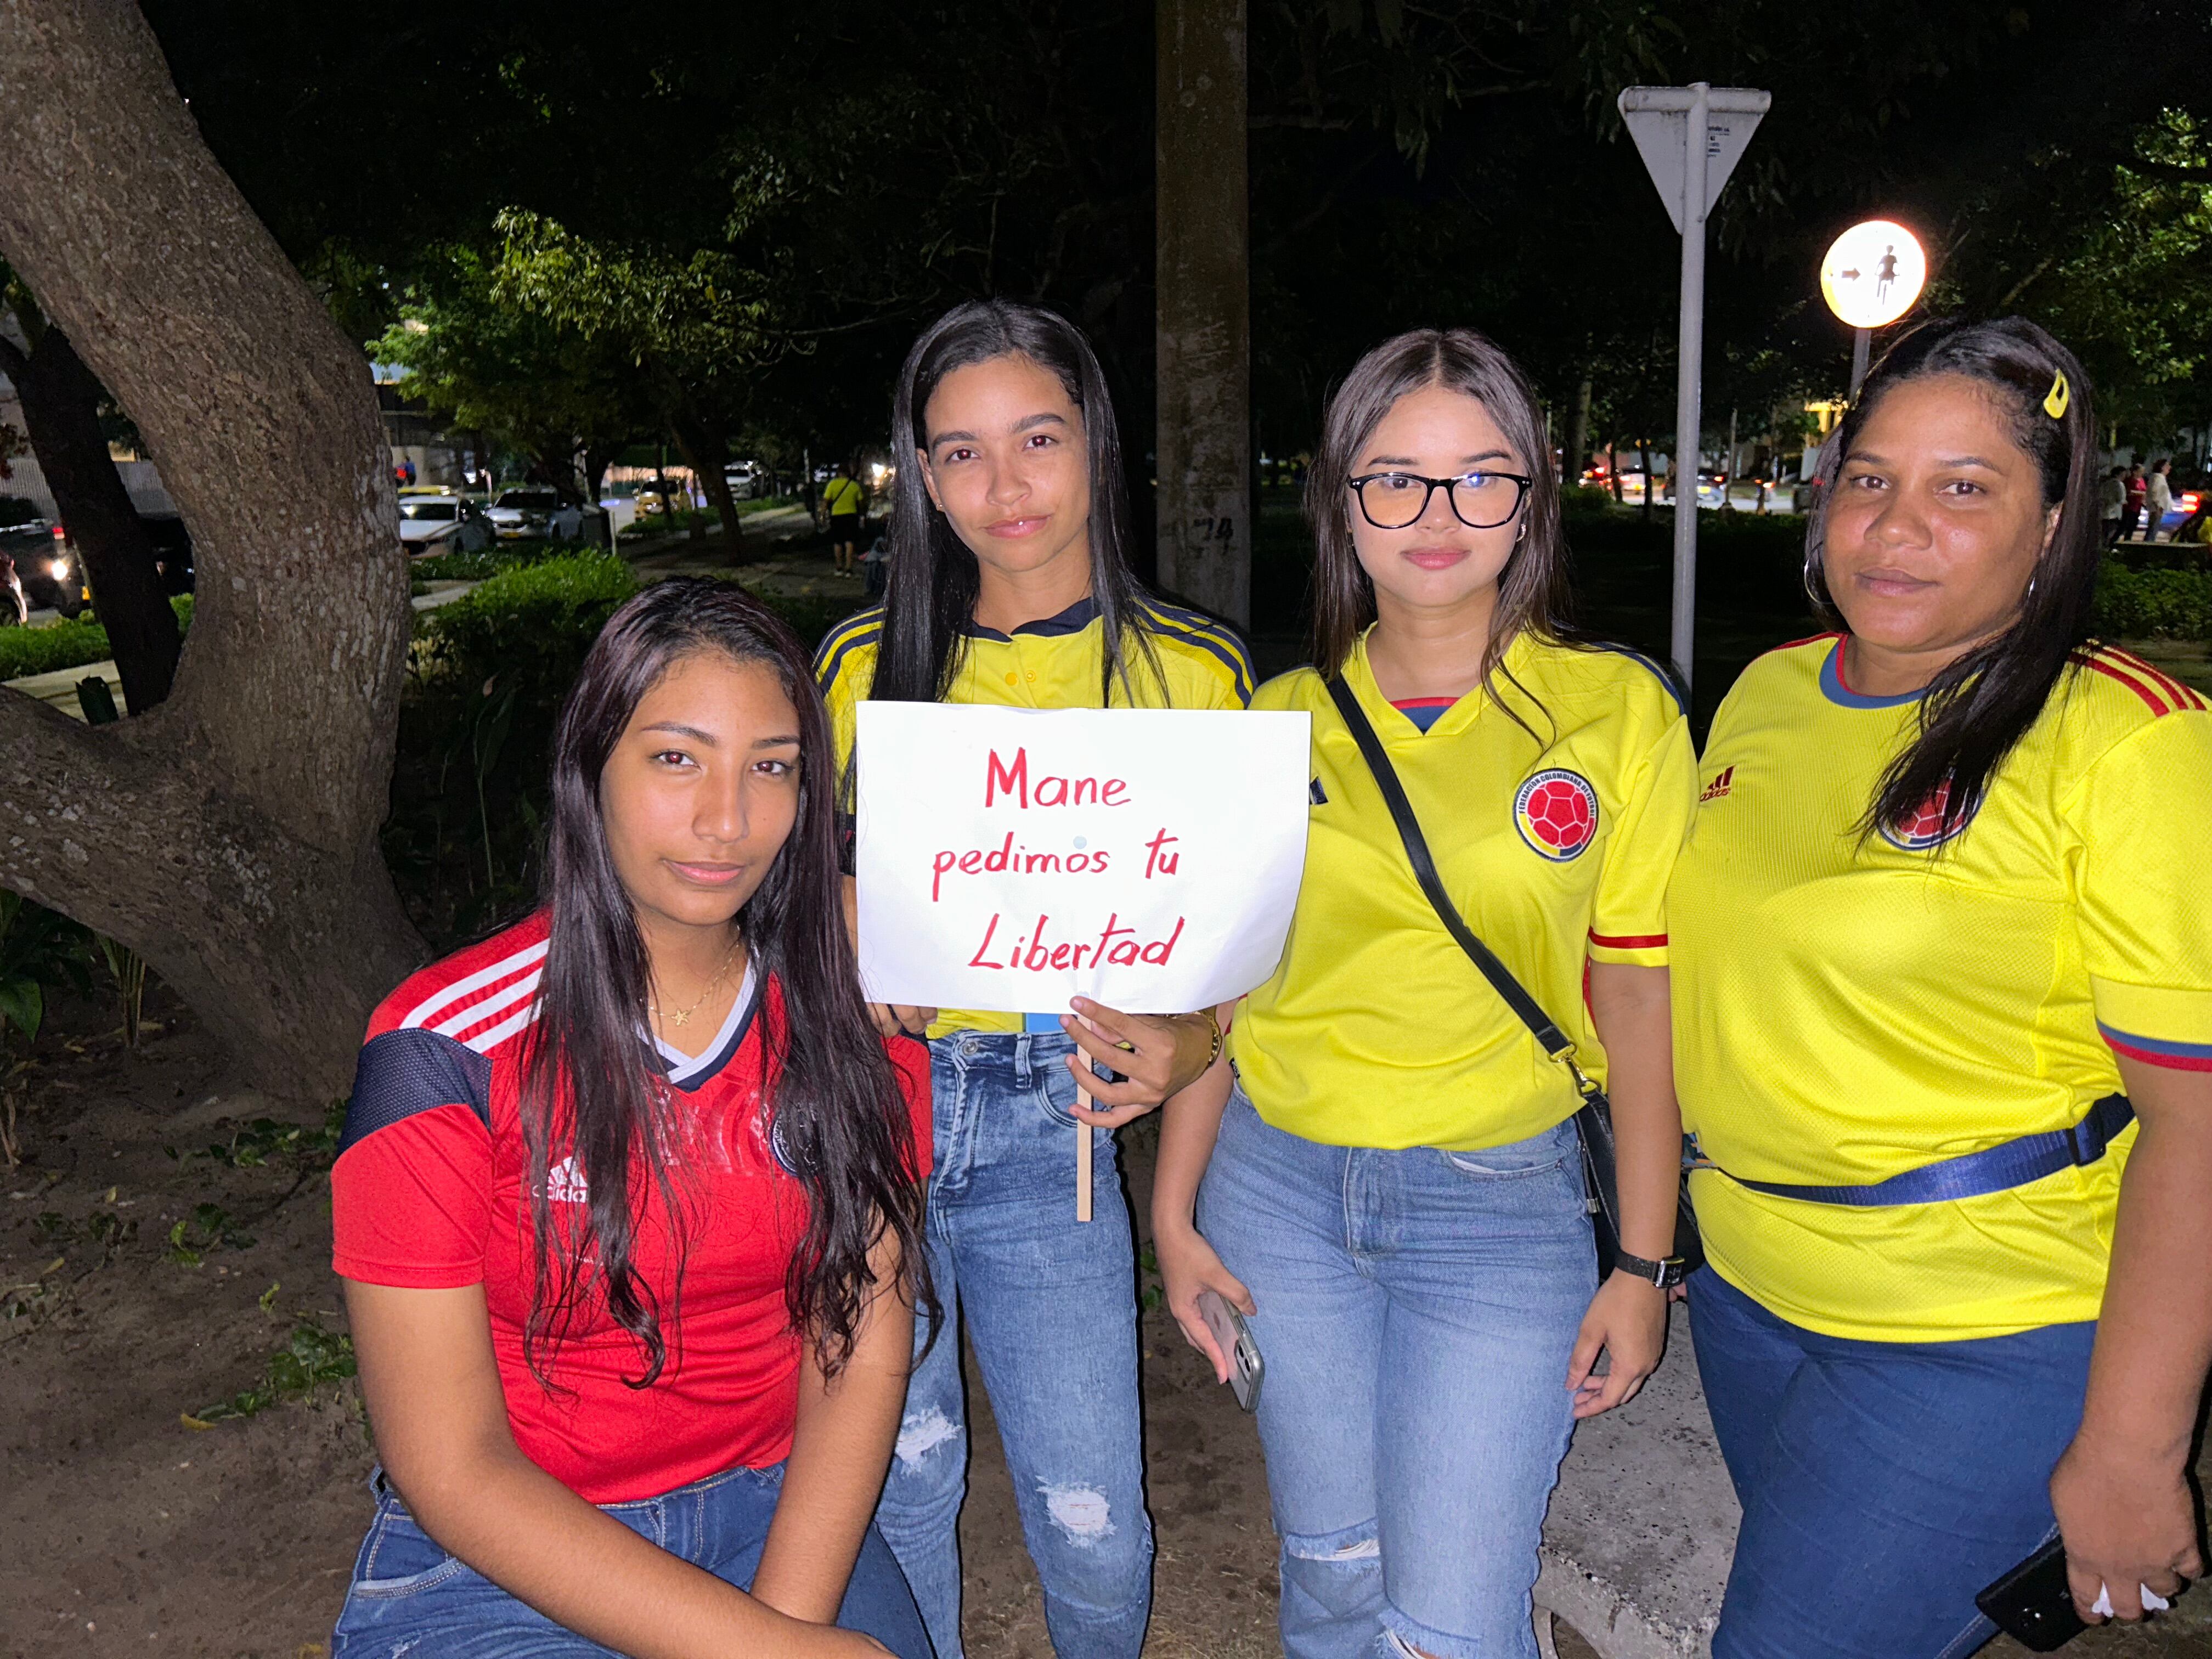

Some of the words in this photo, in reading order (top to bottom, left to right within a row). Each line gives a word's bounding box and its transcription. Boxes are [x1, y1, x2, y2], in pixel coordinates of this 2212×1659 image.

[985, 746, 1131, 809] Mane
[1540, 772, 1582, 787] COLOMBIANA
[1581, 785, 1589, 794] DE
[932, 831, 1110, 902] pedimos
[1144, 827, 1180, 879] tu
[967, 913, 1186, 972] Libertad
